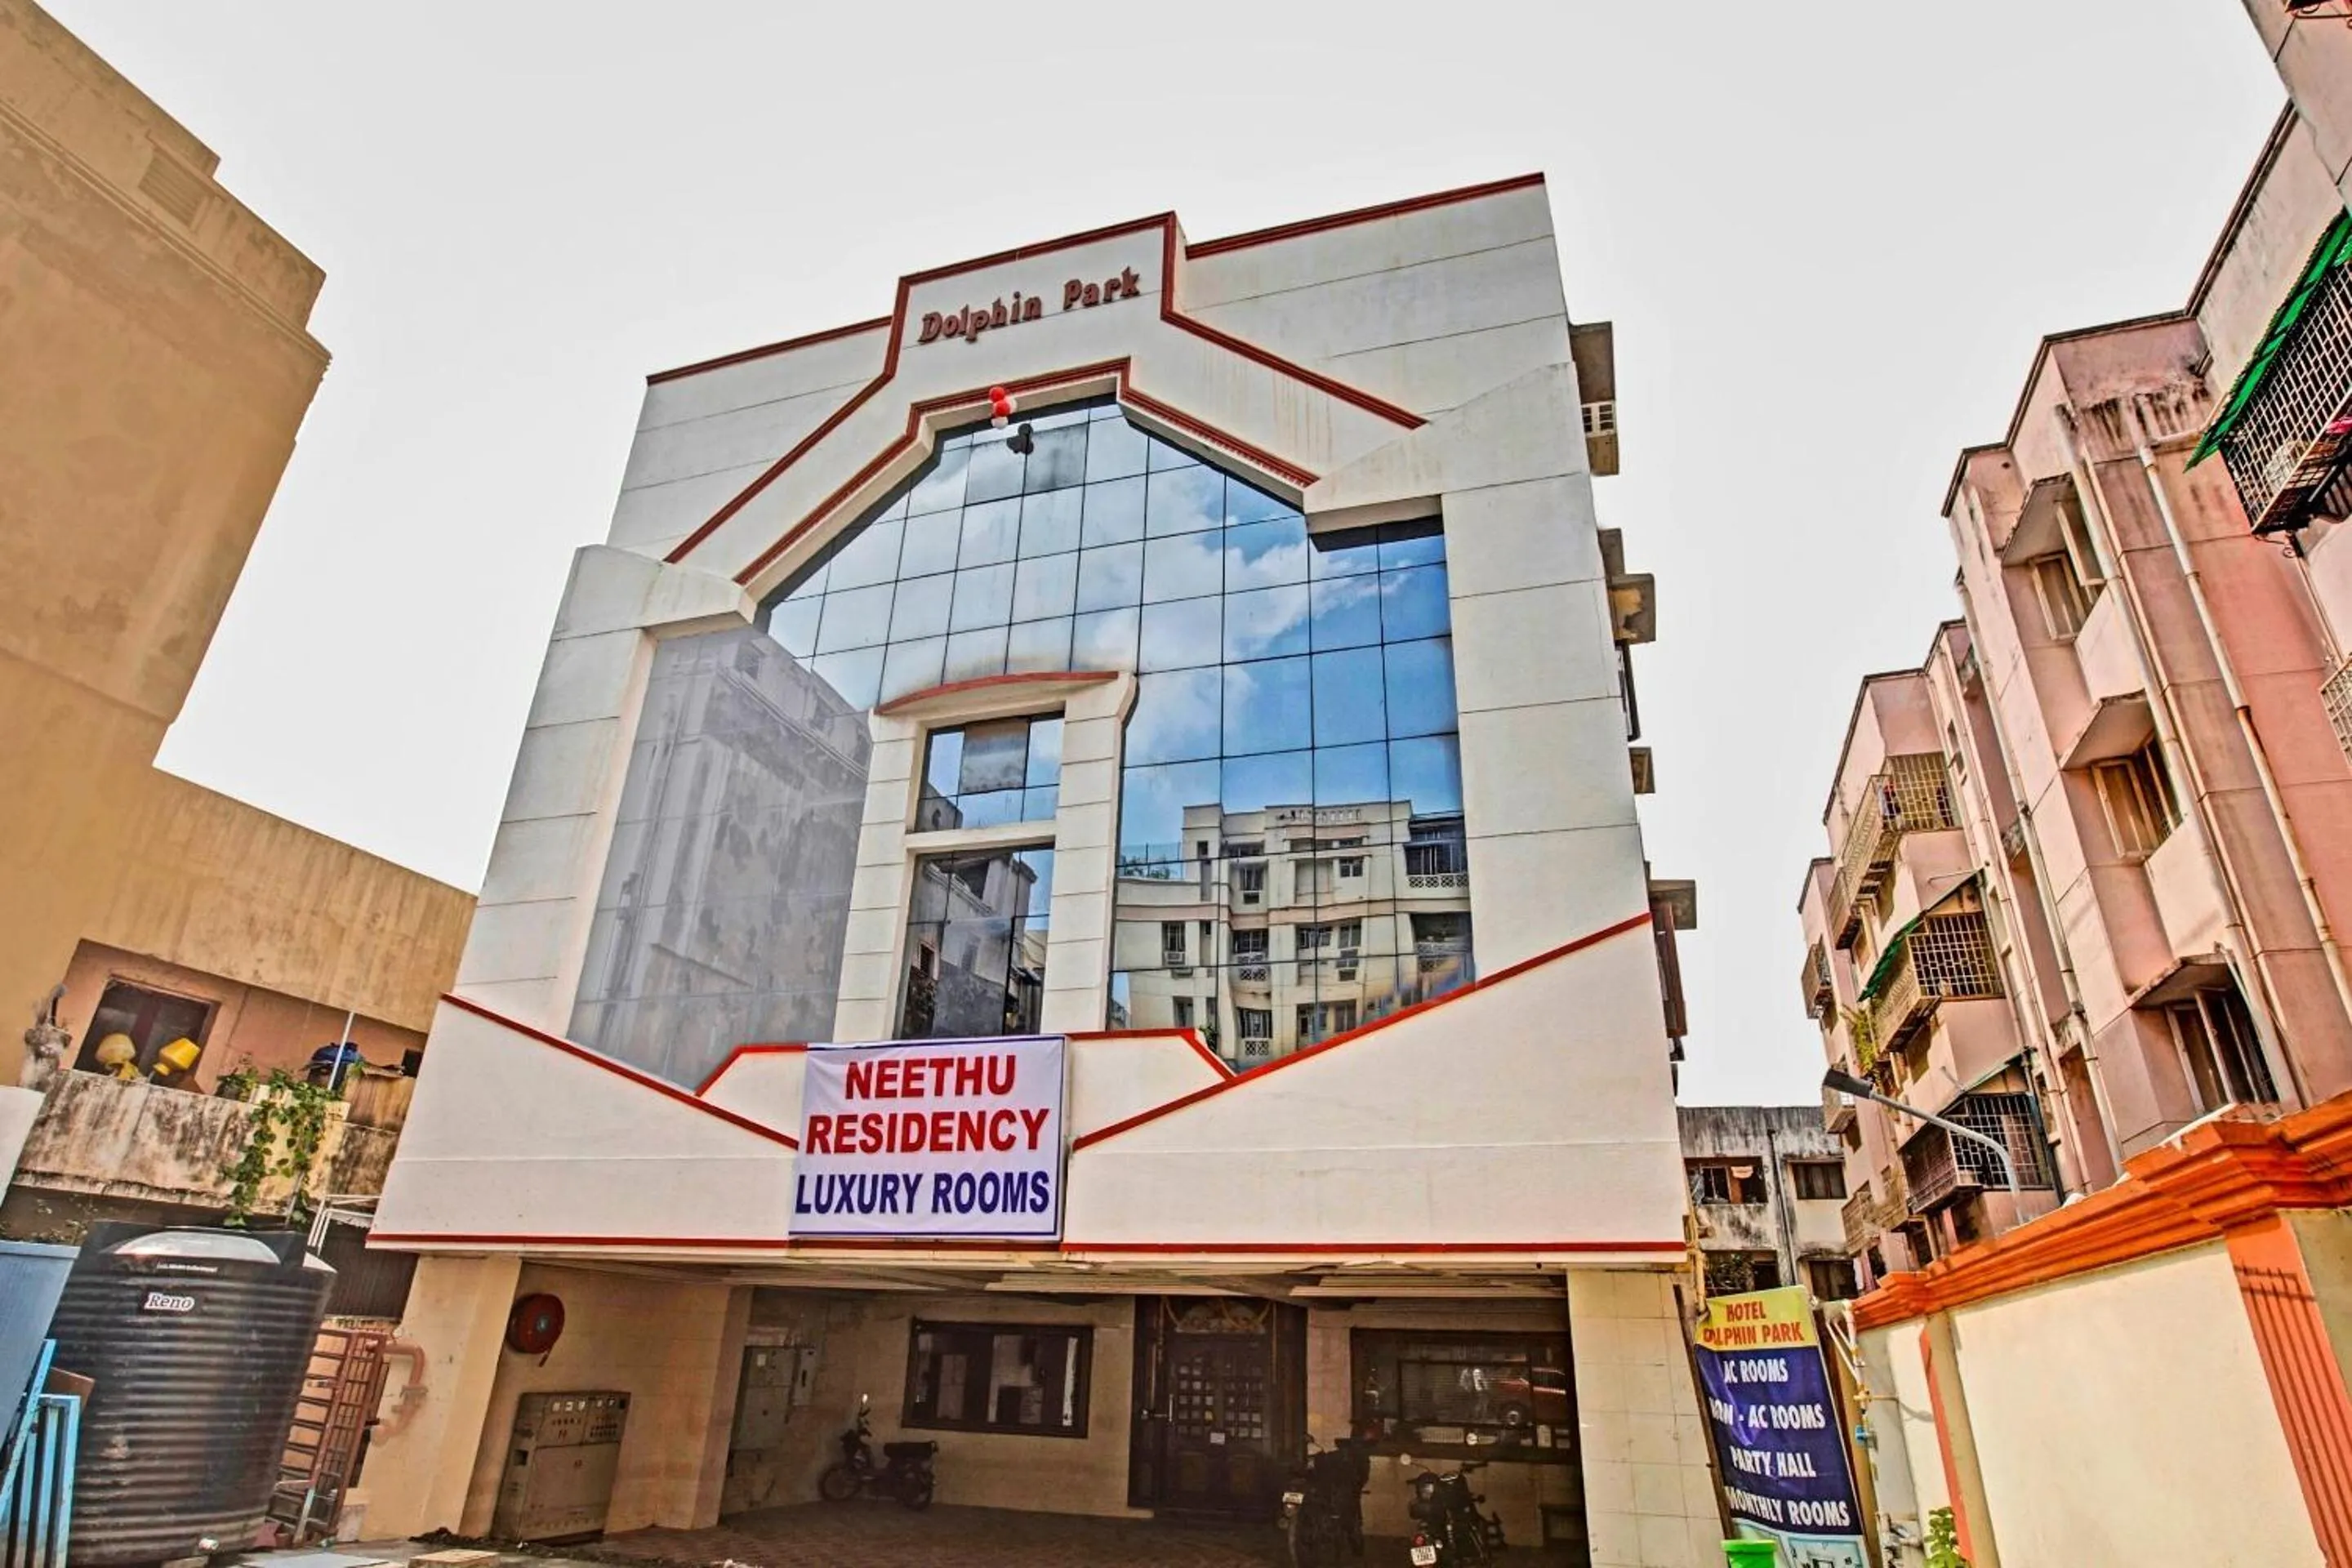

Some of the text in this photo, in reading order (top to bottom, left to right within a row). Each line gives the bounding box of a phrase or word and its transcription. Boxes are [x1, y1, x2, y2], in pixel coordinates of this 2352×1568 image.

[918, 266, 1140, 343] Dolphin Park
[845, 1055, 1017, 1099] NEETHU
[806, 1108, 1050, 1154] RESIDENCY
[795, 1170, 1050, 1214] LUXURY ROOMS
[146, 1293, 194, 1310] Reno
[1726, 1301, 1766, 1322] HOTEL
[1762, 1322, 1805, 1342] PARK
[1740, 1357, 1788, 1383] ROOMS
[1748, 1405, 1768, 1428] AC
[1770, 1403, 1825, 1429] ROOMS
[1730, 1445, 1816, 1477] PARTY HALL
[1724, 1486, 1851, 1526] MONTHLY ROOMS
